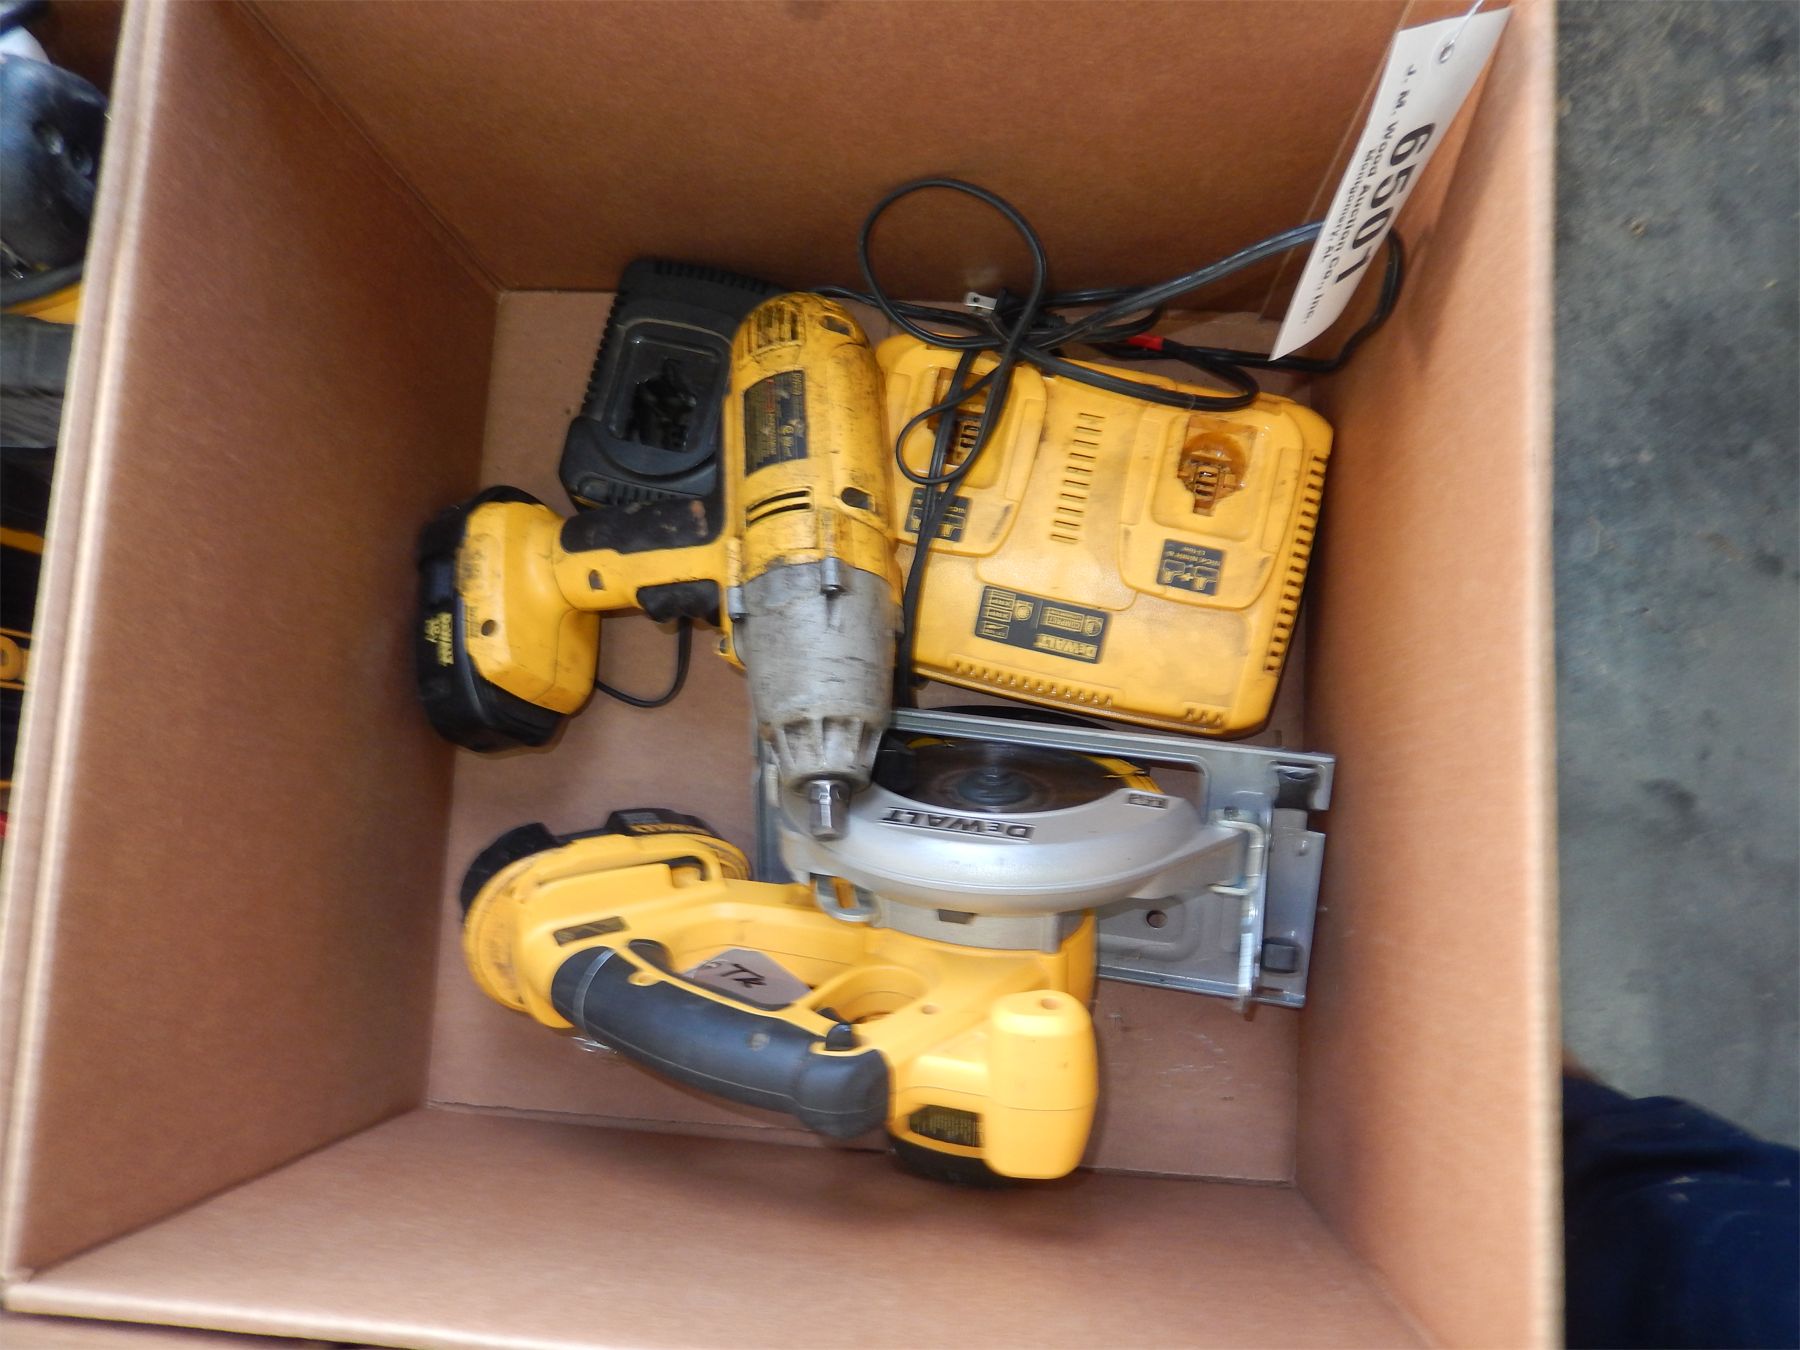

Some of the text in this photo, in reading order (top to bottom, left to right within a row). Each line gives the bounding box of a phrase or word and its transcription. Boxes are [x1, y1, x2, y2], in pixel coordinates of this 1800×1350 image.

[1392, 90, 1409, 115] M.
[1367, 122, 1397, 176] Wood
[1335, 122, 1438, 283] 6501
[1335, 184, 1370, 251] Auction
[1303, 294, 1323, 323] Inc.
[1034, 634, 1097, 659] DEWALT
[881, 808, 1033, 839] DEWALT
